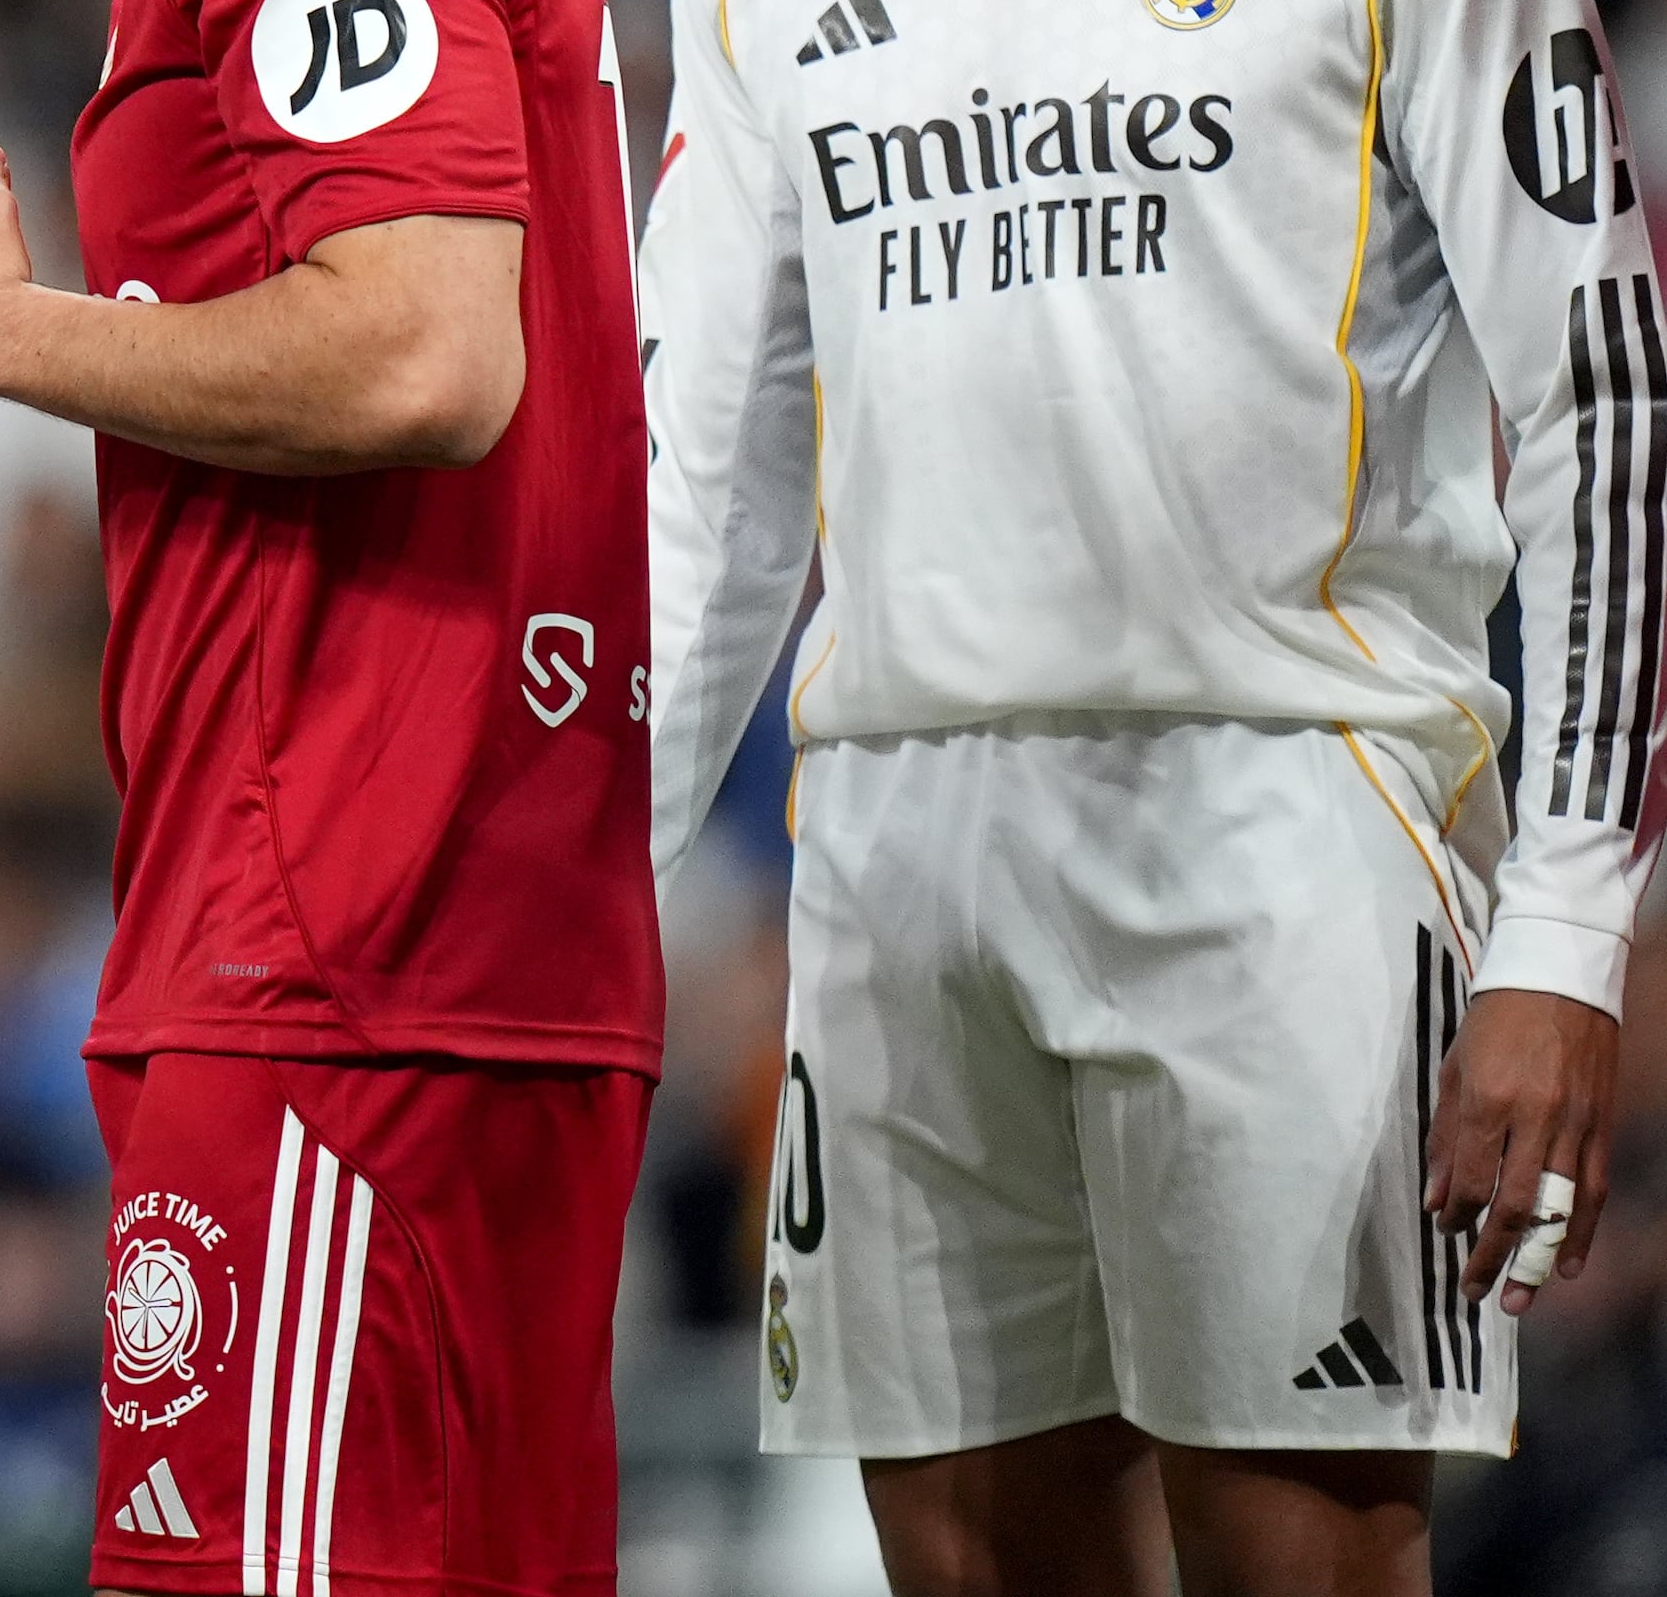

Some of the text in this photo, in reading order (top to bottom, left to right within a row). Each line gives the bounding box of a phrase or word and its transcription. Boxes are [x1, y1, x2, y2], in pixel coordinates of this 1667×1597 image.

[807, 78, 1234, 224] Emirates
[879, 194, 1166, 311] FLY BETTER
[113, 1191, 228, 1252] JUICE TIME
